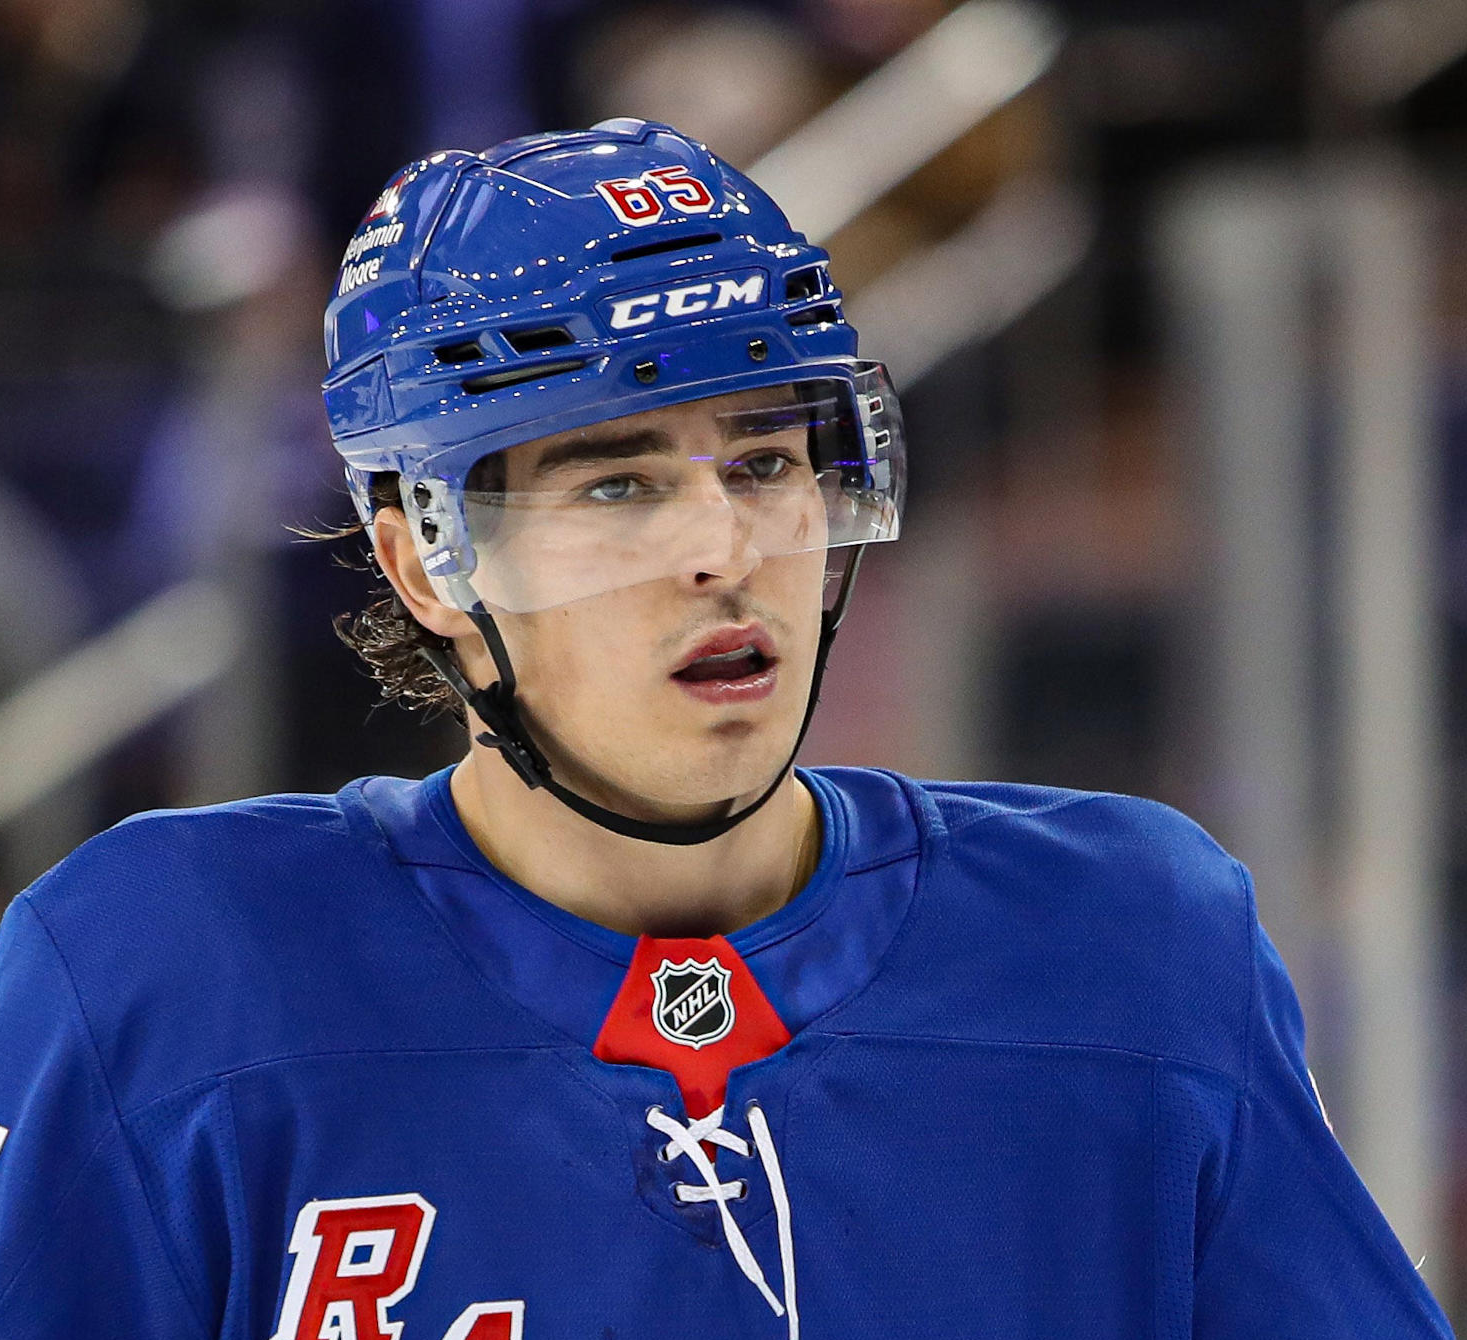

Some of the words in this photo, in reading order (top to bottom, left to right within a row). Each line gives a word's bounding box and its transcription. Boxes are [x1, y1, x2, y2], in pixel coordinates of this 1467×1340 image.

[594, 164, 716, 229] 65
[609, 273, 766, 331] CCM
[673, 982, 717, 1029] NHL
